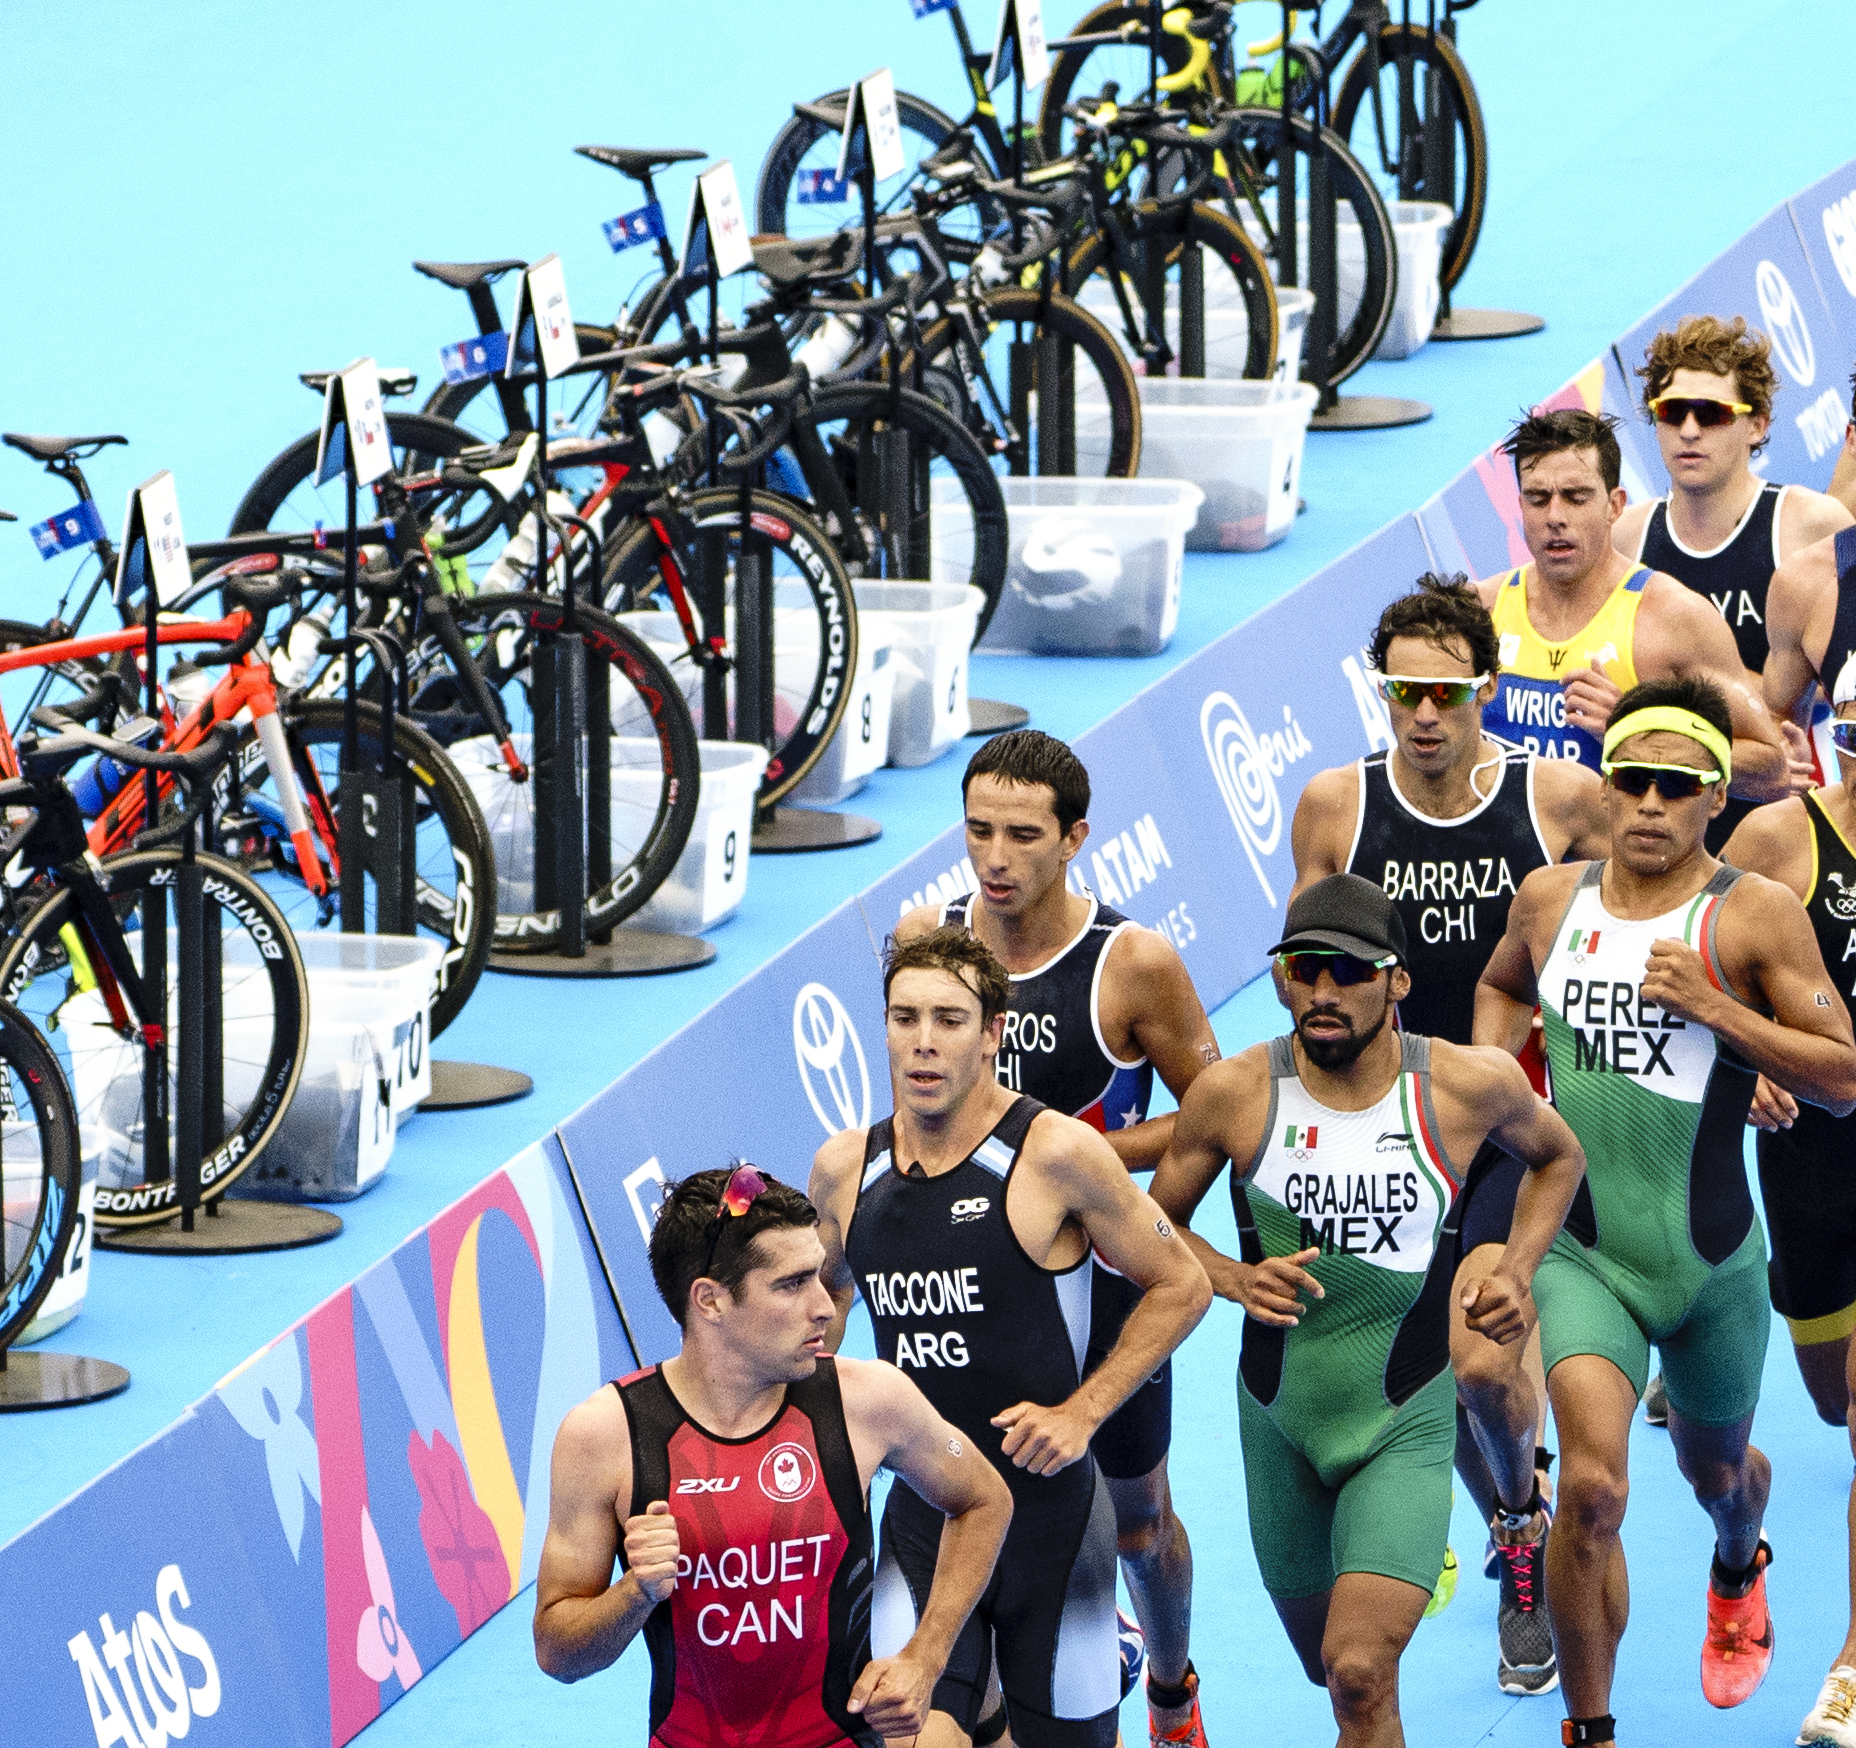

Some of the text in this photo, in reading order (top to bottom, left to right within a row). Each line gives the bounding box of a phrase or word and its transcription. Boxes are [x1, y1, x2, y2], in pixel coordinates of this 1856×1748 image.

[791, 533, 845, 736] REYNOLDS
[860, 692, 872, 744] 8
[1505, 686, 1571, 729] WRIG
[723, 829, 737, 884] 9
[1383, 857, 1518, 900] BARRAZA
[1420, 904, 1476, 944] CHI
[1002, 1010, 1057, 1053] ROS
[1574, 1028, 1675, 1077] MEX
[995, 1052, 1022, 1091] HI
[1285, 1172, 1418, 1215] GRAJALES
[1299, 1215, 1404, 1256] MEX
[865, 1267, 984, 1316] TACCONE
[896, 1331, 970, 1368] ARG
[676, 1476, 740, 1495] 2XU
[697, 1595, 803, 1647] CAN
